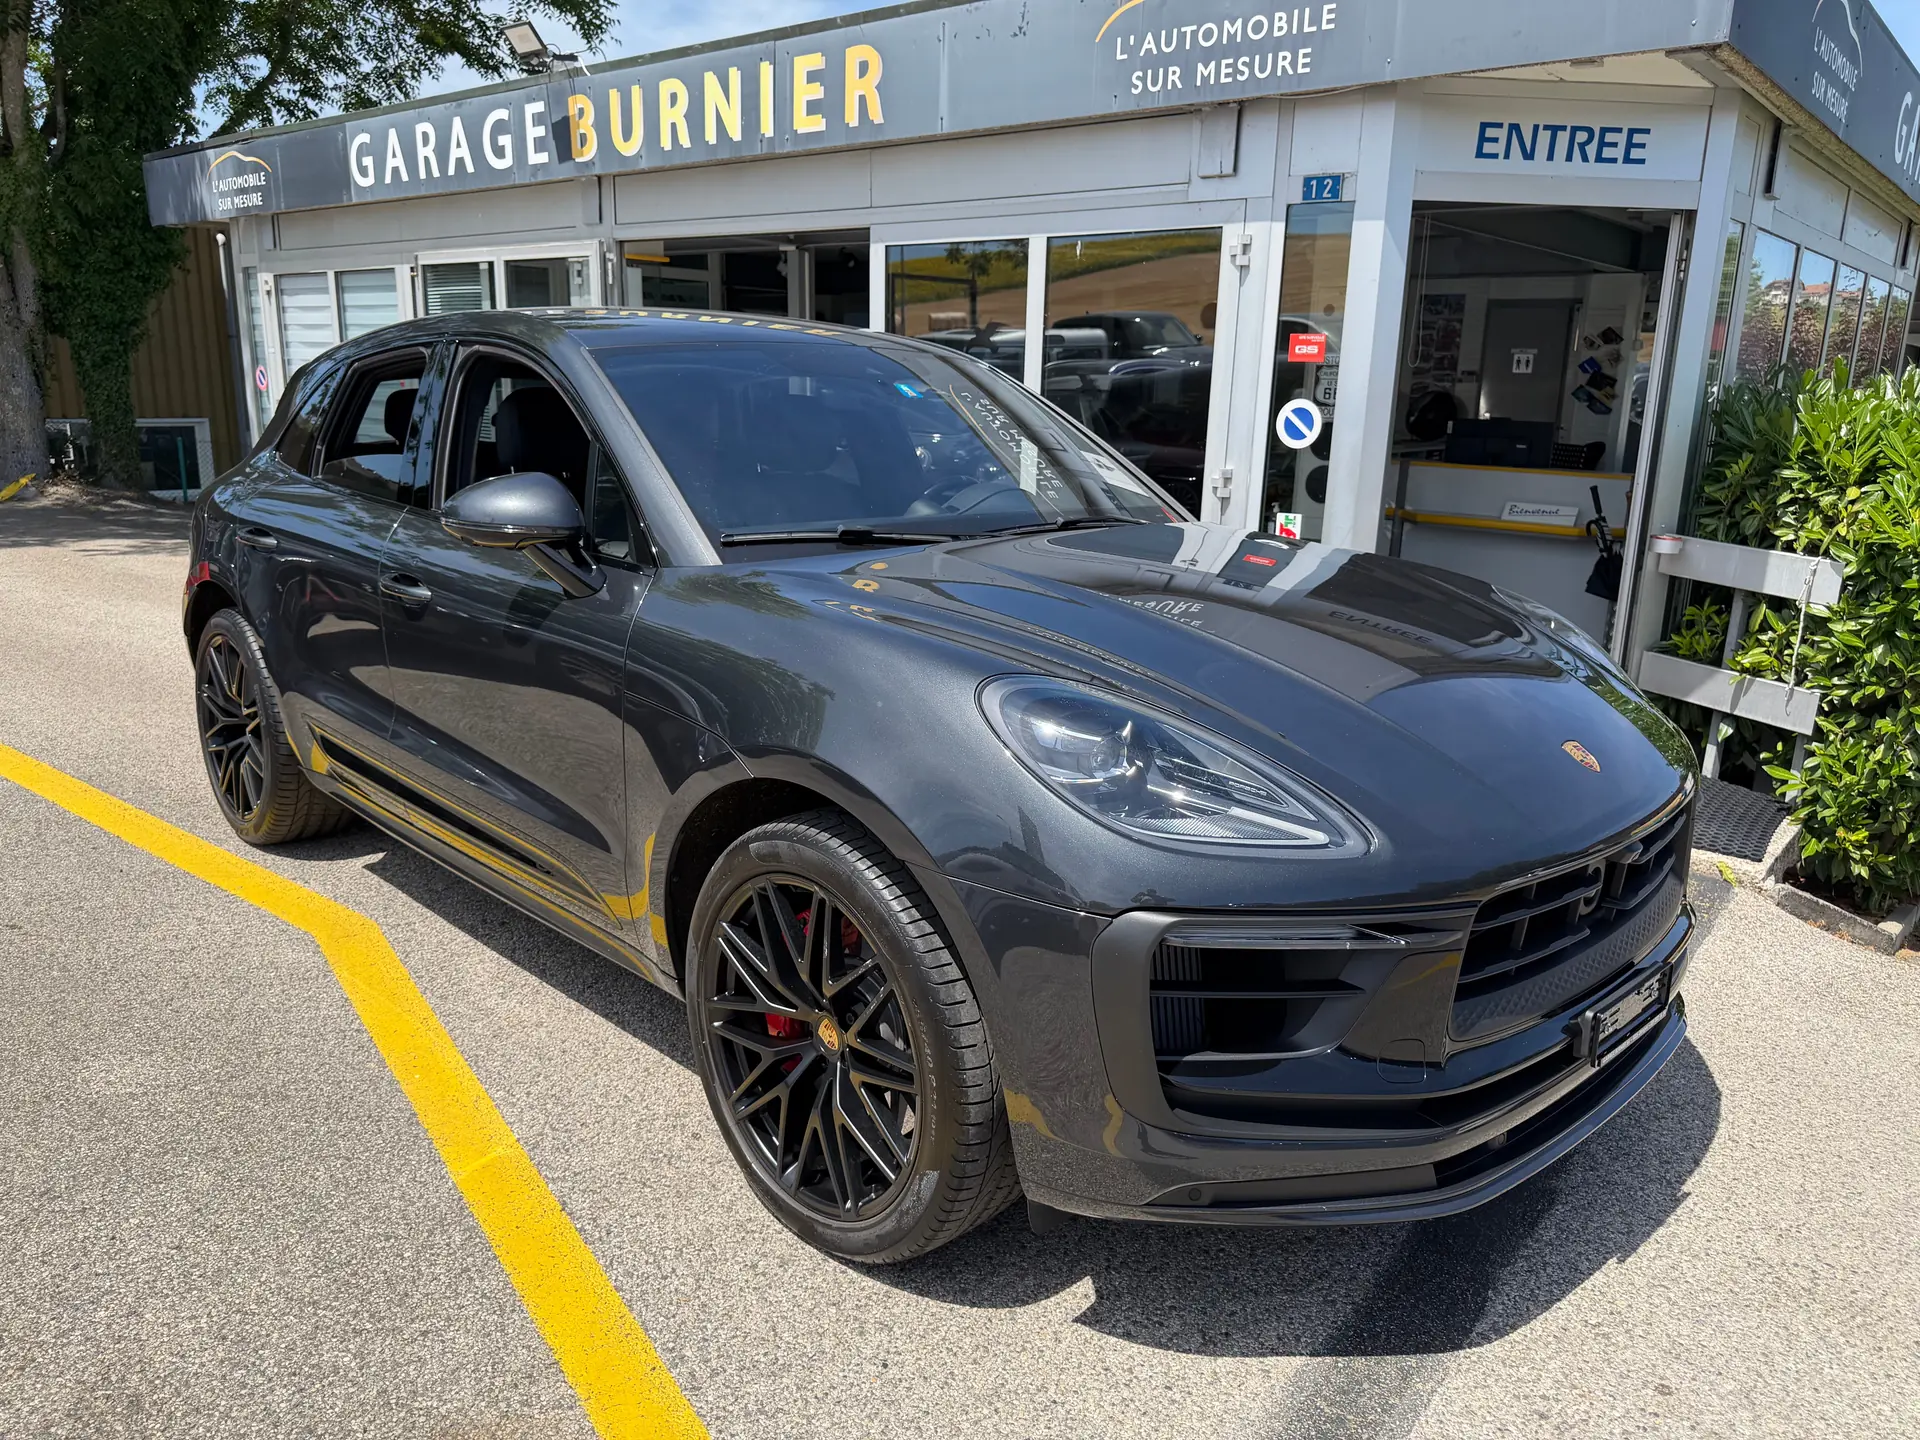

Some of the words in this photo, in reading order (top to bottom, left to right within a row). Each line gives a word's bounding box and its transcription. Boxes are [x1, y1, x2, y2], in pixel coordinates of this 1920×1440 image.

[1115, 3, 1337, 60] L'AUTOMOBILE
[1131, 65, 1183, 95] SUR
[1196, 47, 1312, 87] MESURE
[1813, 26, 1858, 92] L'AUTOMOBILE
[350, 100, 549, 188] GARAGE
[569, 43, 885, 163] BURNIER
[1811, 70, 1826, 103] SUR
[1825, 83, 1849, 123] MESURE
[1474, 121, 1652, 165] ENTREE
[1895, 91, 1920, 184] GA
[212, 171, 267, 193] L'AUTOMOBILE
[218, 196, 233, 211] SUR
[233, 192, 263, 209] MESURE
[1310, 178, 1333, 199] 12
